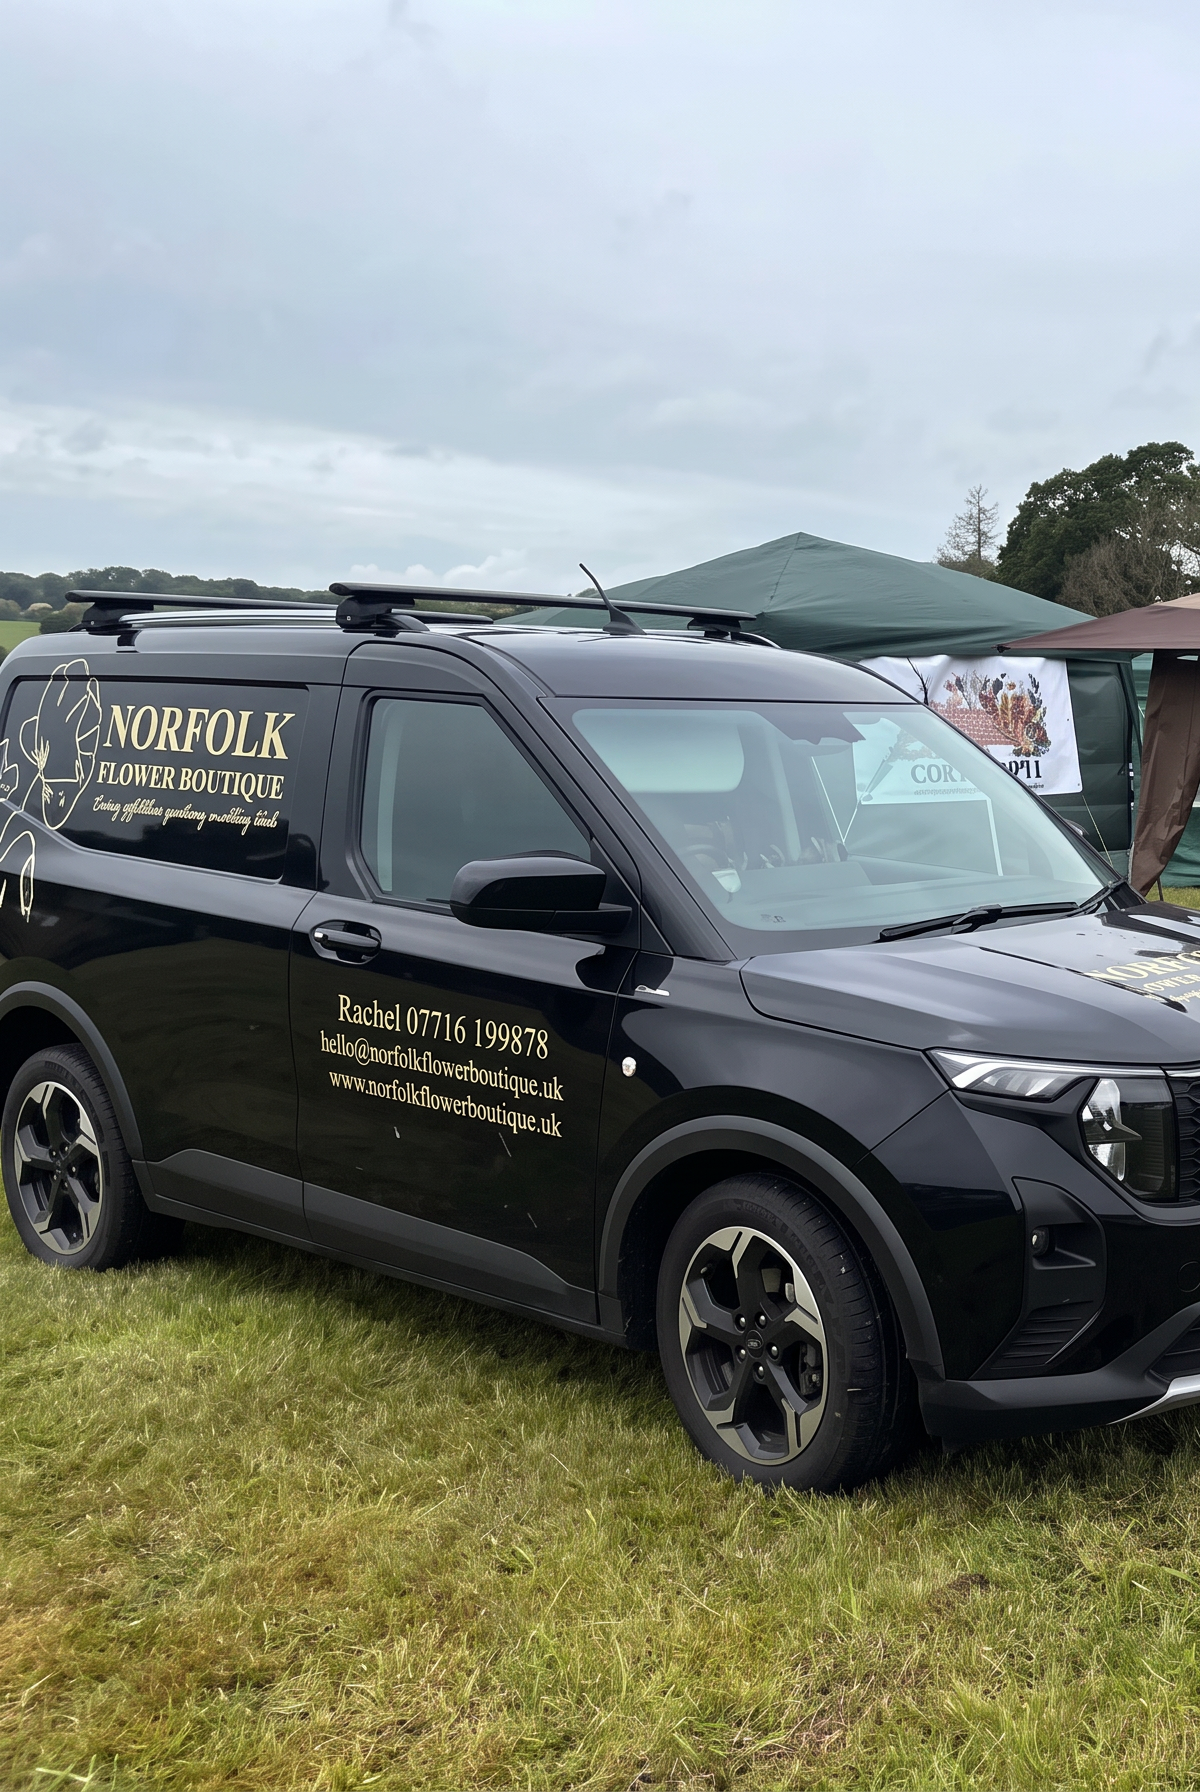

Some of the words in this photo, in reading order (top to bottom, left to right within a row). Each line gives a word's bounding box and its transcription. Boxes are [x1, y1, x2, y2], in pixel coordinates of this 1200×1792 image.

[103, 705, 295, 759] NORFOLK
[97, 761, 175, 790] FLOWER
[178, 767, 284, 802] BOUTIQUE
[338, 994, 401, 1032] Rachel
[407, 1007, 466, 1044] 07716
[475, 1018, 549, 1060] 199878
[320, 1030, 564, 1101] hello@norfolkflowerboutique.uk
[329, 1071, 562, 1138] www.norfolkflowerboutique.uk
